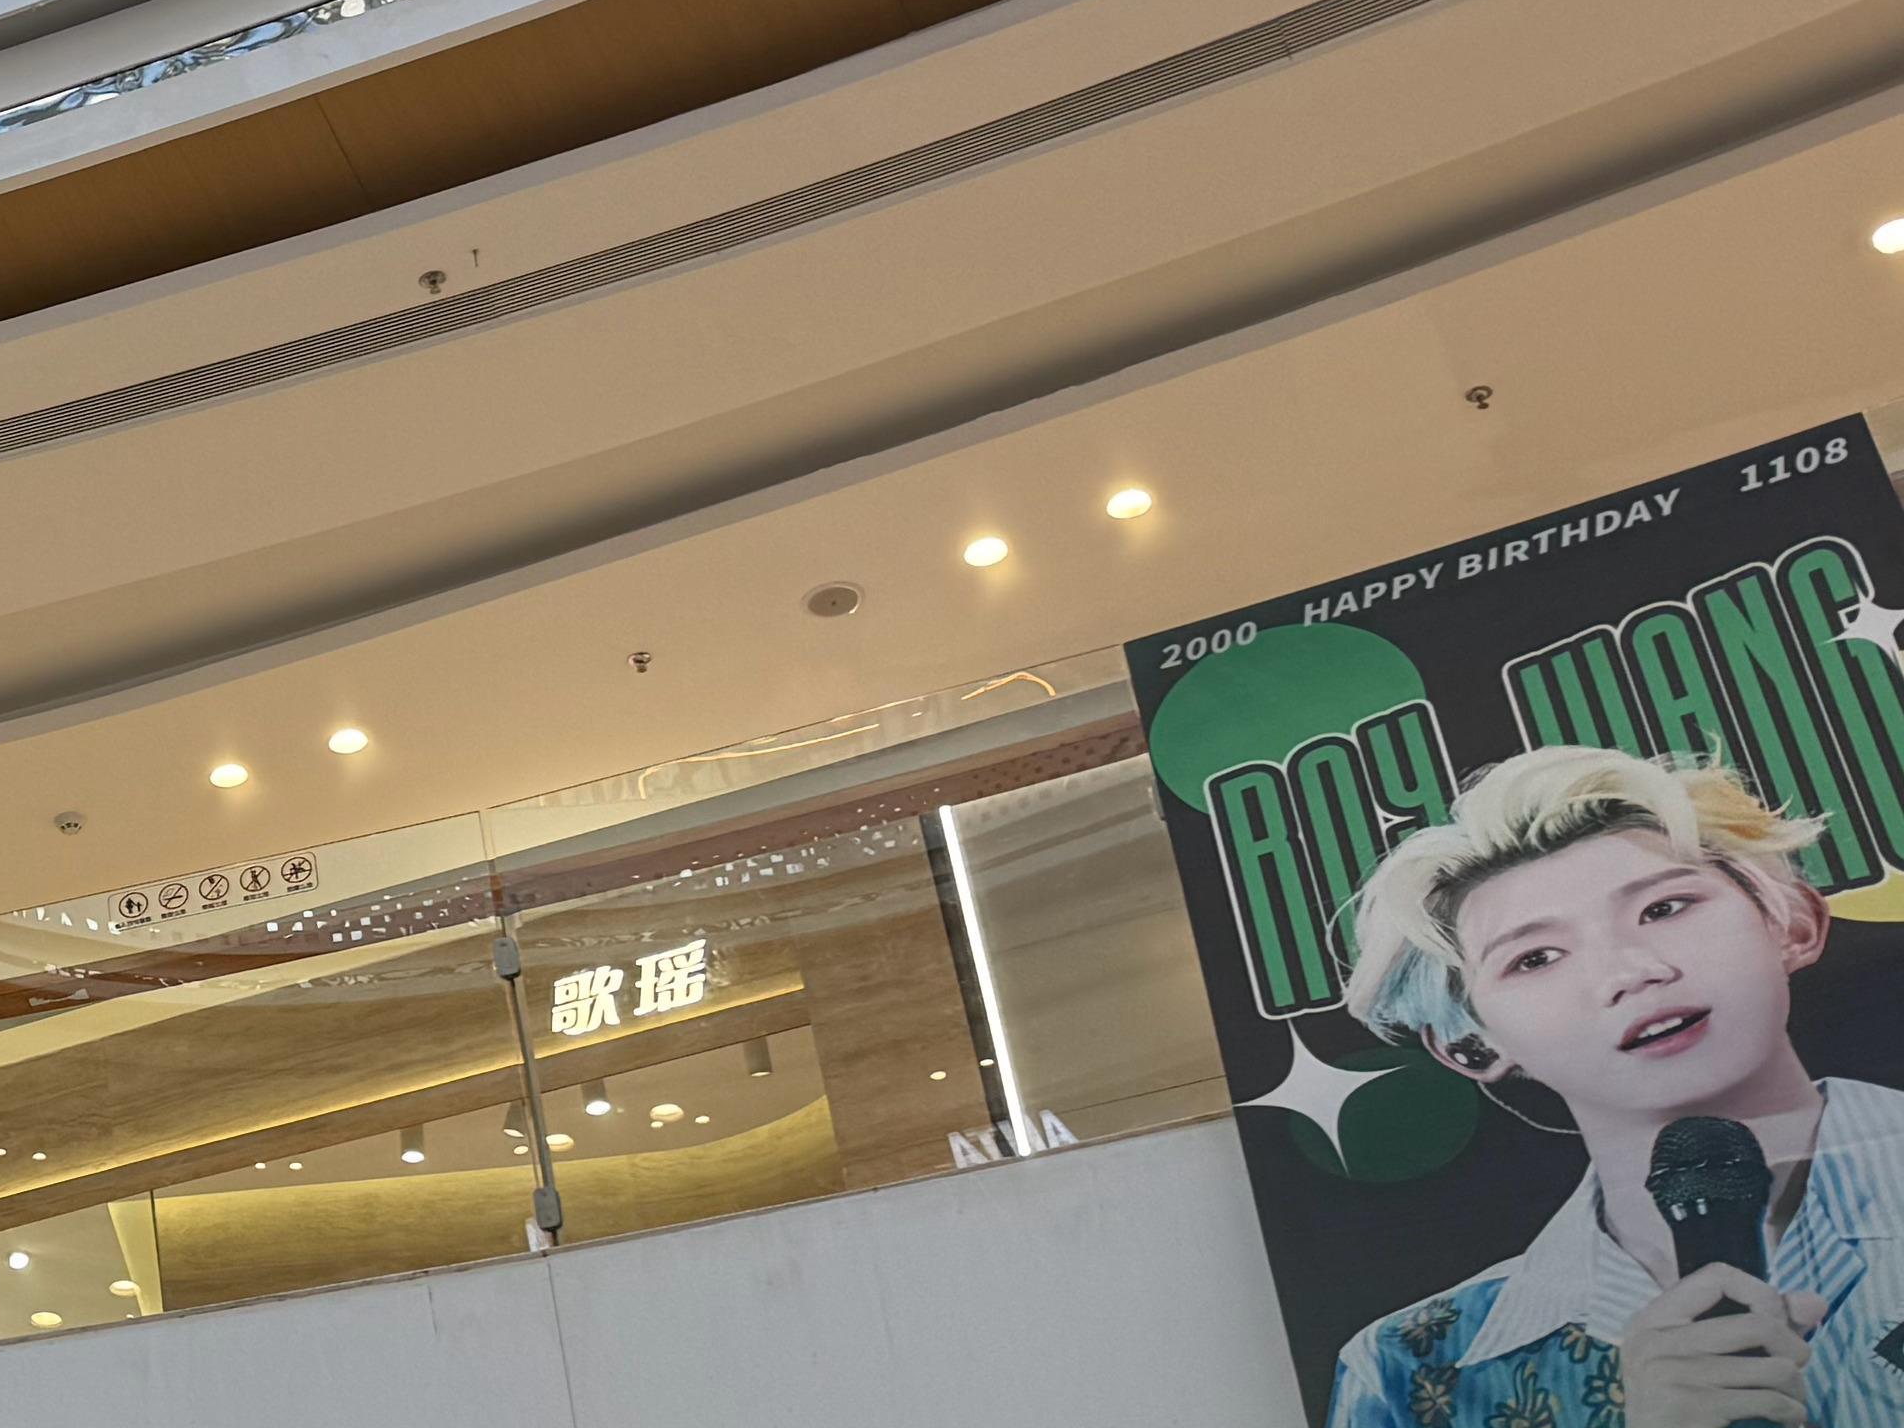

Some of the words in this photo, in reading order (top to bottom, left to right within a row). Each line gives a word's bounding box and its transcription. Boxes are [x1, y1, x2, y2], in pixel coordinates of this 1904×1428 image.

[1159, 621, 1258, 670] 2000
[1302, 563, 1444, 627] HAPPY
[1455, 488, 1682, 580] BIRTHDAY
[1739, 437, 1850, 493] 1108
[551, 939, 706, 1035] 歌瑶
